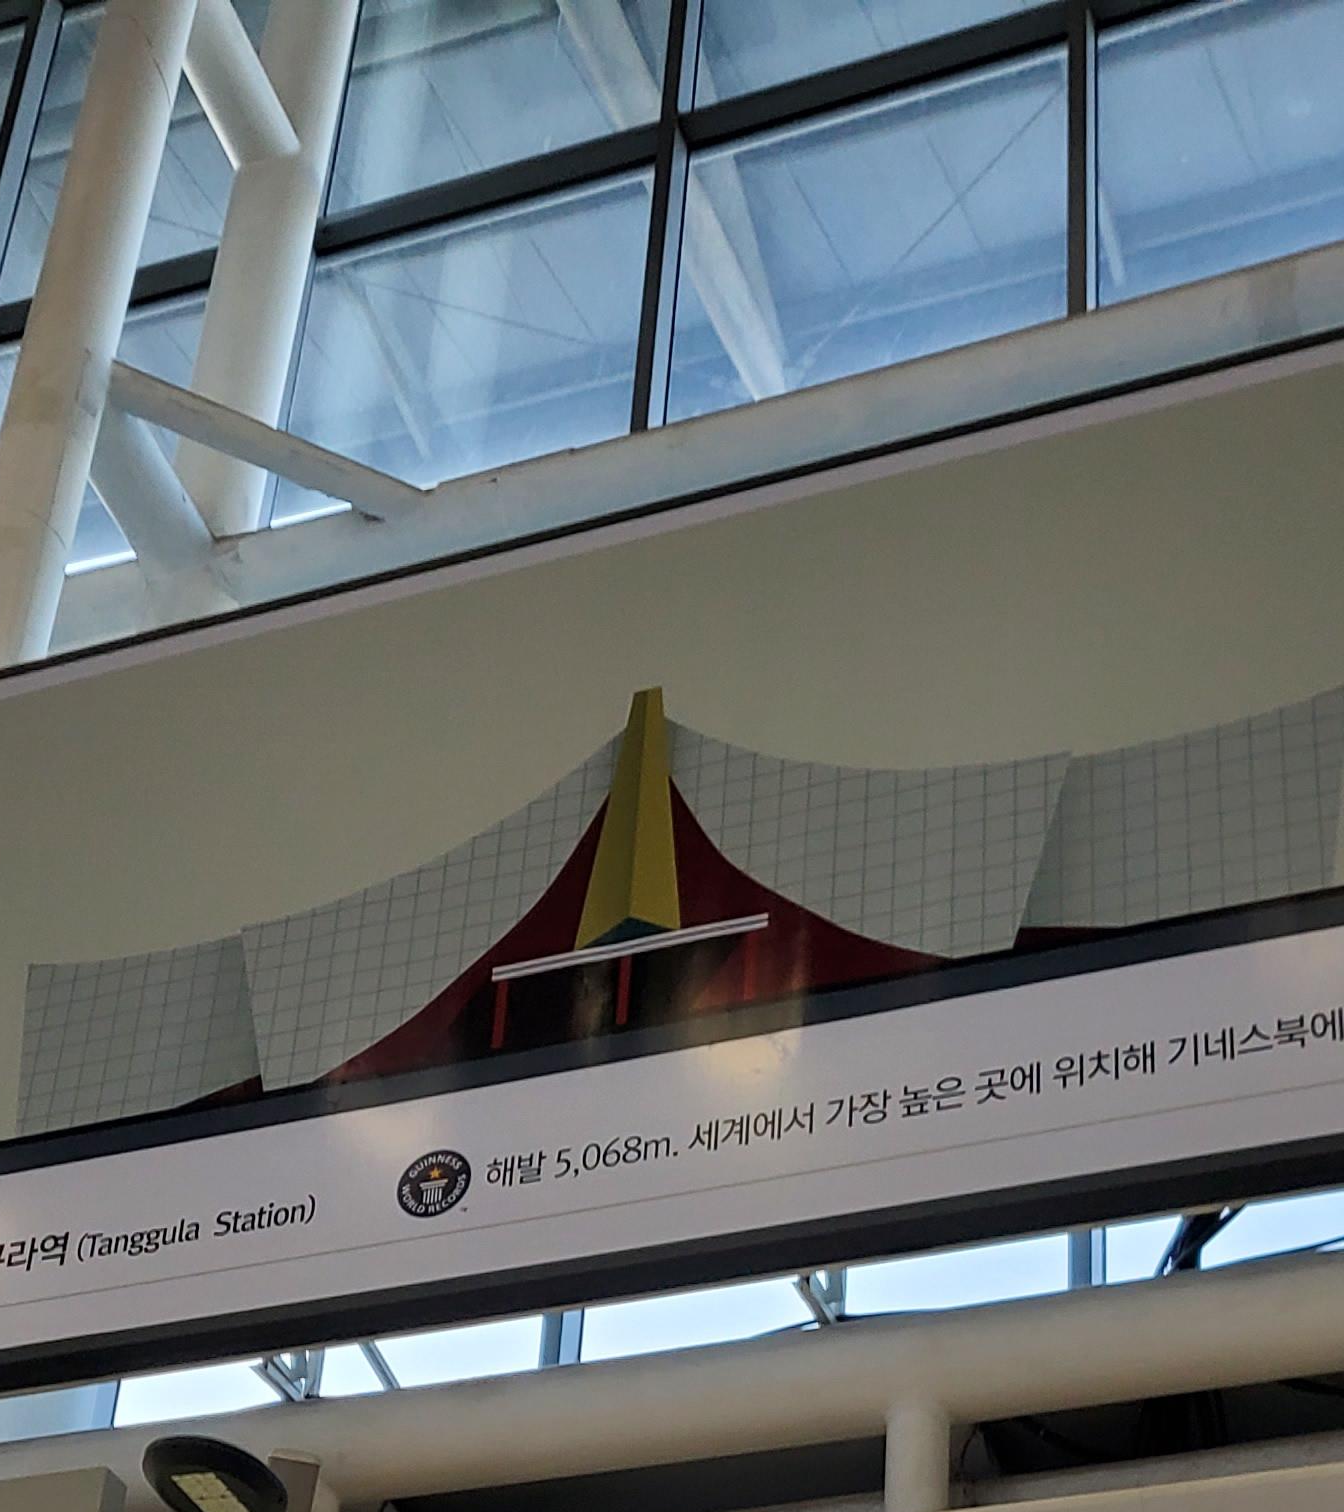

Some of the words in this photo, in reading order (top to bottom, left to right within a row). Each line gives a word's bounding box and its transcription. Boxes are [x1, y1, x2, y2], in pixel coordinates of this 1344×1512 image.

[485, 1149, 546, 1188] 해발
[554, 1135, 680, 1181] 5,068m.
[687, 1102, 816, 1154] 세계에서
[825, 1088, 892, 1129] 가장
[897, 1076, 966, 1120] 높은
[972, 1061, 1043, 1106] 곳에
[1052, 1041, 1156, 1091] 위치해
[1167, 1006, 1344, 1070] 기네스북에
[401, 1183, 426, 1214] WORLD
[427, 1173, 467, 1214] RECORDS
[409, 1153, 463, 1179] GUINNESS
[77, 1218, 200, 1264] (Tanggula
[212, 1194, 317, 1237] Station)
